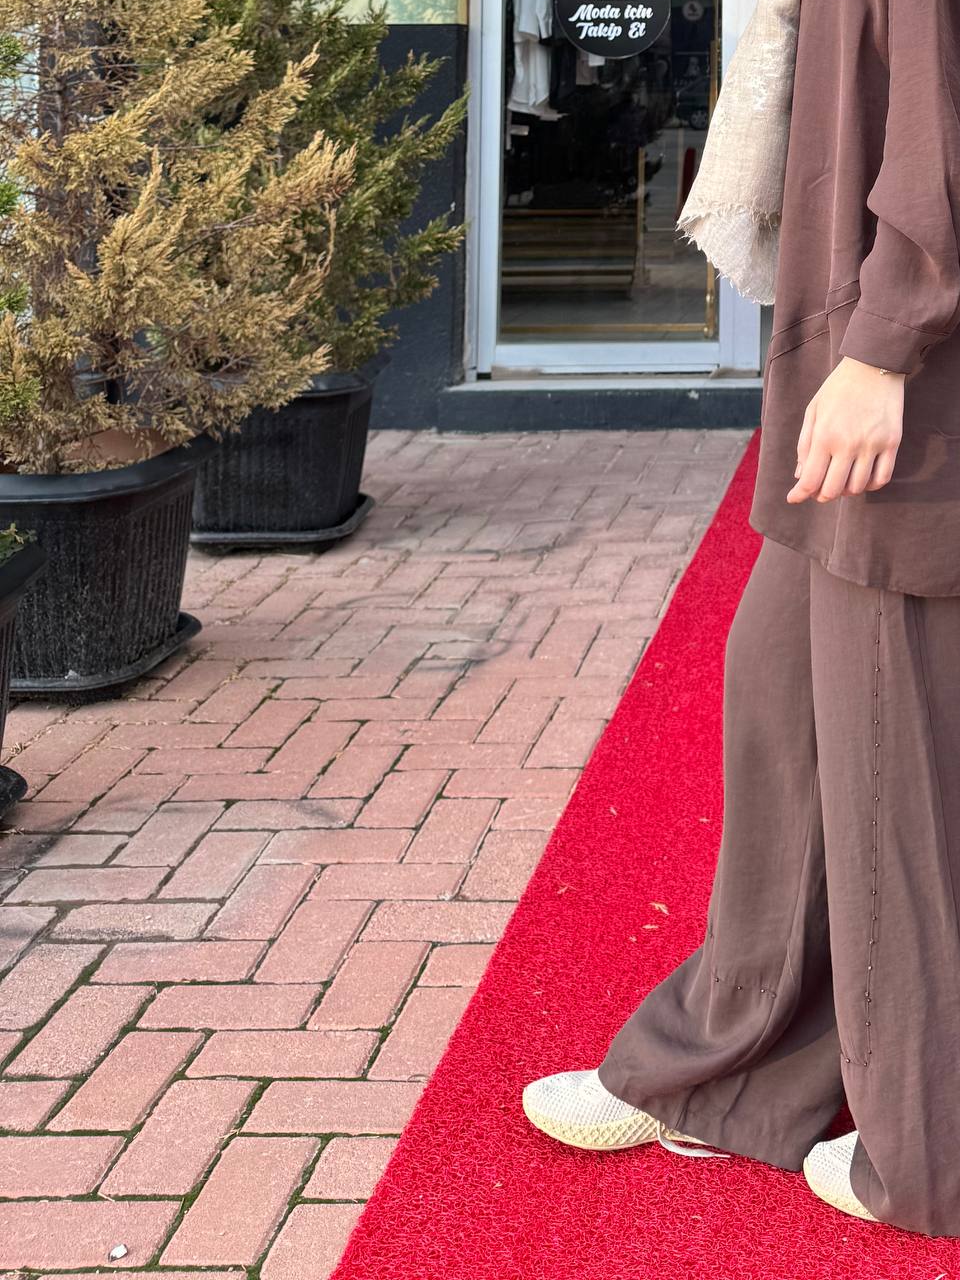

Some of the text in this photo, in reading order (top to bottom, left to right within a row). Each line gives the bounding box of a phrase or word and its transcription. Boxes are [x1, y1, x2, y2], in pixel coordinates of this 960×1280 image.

[568, 4, 654, 22] Moda için
[576, 22, 622, 40] Takip
